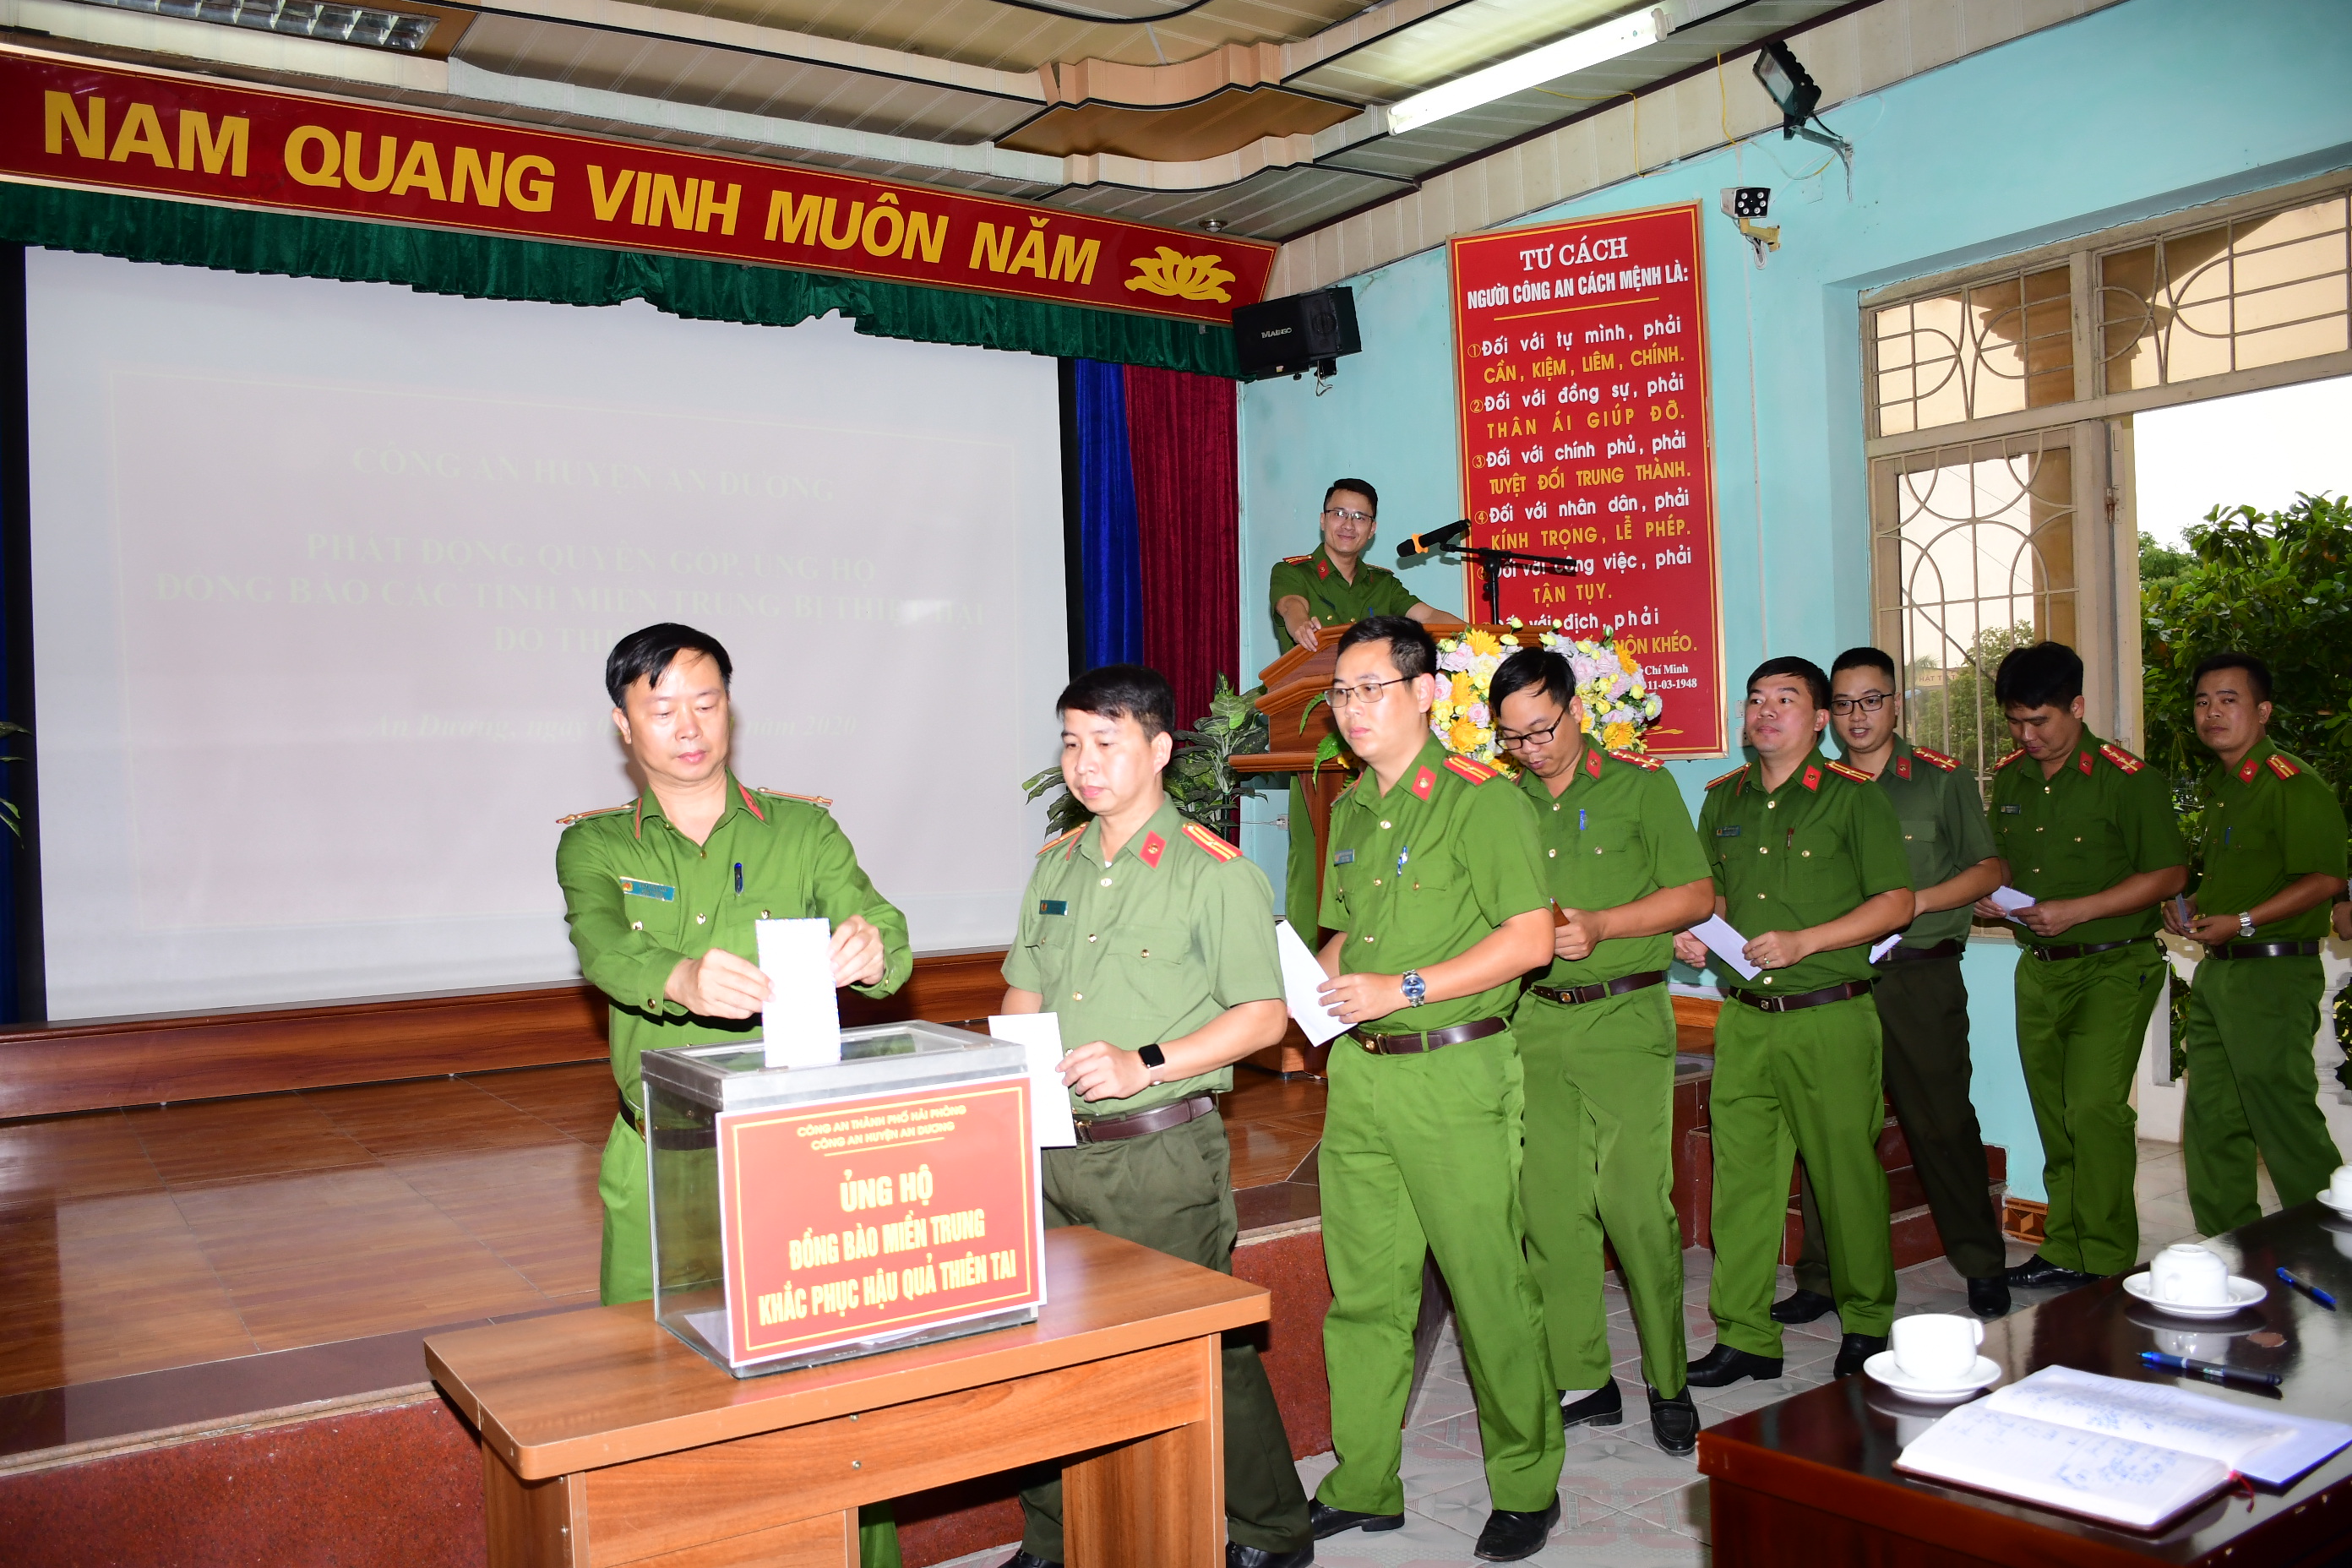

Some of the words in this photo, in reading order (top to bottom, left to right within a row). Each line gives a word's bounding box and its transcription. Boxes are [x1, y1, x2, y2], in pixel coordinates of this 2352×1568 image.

[44, 90, 250, 178] NAM
[284, 124, 556, 213] QUANG
[591, 165, 742, 237] VINH
[765, 192, 951, 264] MUÔN
[969, 216, 1102, 286] NĂM
[1520, 244, 1554, 271] TƯ
[1559, 235, 1629, 266] CÁCH
[1467, 282, 1509, 309] NGƯỜI
[1512, 280, 1550, 304] CÔNG
[1554, 280, 1574, 298] AN
[1578, 271, 1615, 296] CÁCH
[1620, 264, 1661, 292] MỆNH
[1665, 259, 1689, 282] LÀ:
[1482, 335, 1508, 357] Đối
[1520, 331, 1544, 351] với
[1556, 331, 1572, 351] tự
[1643, 314, 1681, 340] phải
[1631, 342, 1685, 368] CHÍNH.
[1484, 391, 1510, 412] Đối
[1522, 389, 1546, 408] với
[1558, 383, 1599, 405] đồng
[1647, 372, 1684, 398] phải
[1487, 416, 1537, 439] THÂN
[1552, 410, 1571, 433] ÁI
[1587, 404, 1635, 428] GIÚP
[1650, 400, 1685, 422] ĐỠ.
[1486, 447, 1511, 468] Đối
[1522, 444, 1544, 464] với
[1554, 440, 1595, 461] chính
[1652, 429, 1686, 455] phải
[352, 440, 461, 479] CÔNG
[472, 455, 520, 482] AN
[533, 457, 653, 495] HUYỆN
[662, 467, 708, 494] AN
[718, 468, 835, 504] DƯƠNG
[1489, 473, 1527, 497] TUYỆT
[1538, 466, 1565, 491] ĐỐI
[1576, 467, 1625, 487] TRUNG
[1636, 457, 1691, 482] THÀNH.
[1489, 503, 1513, 524] Đối
[1525, 501, 1547, 520] với
[1559, 498, 1596, 517] nhân
[1654, 487, 1690, 512] phải
[1491, 527, 1529, 551] KÍNH
[1615, 514, 1632, 541] LỄ
[1645, 514, 1691, 538] PHÉP.
[307, 529, 409, 565] PHÁT
[537, 538, 659, 575] QUYÊN
[1655, 545, 1692, 569] phải
[381, 575, 458, 608] CÁC
[670, 588, 781, 619] TRUNG
[1533, 582, 1566, 608] TẬN
[1576, 583, 1613, 606] TỤY.
[1614, 606, 1659, 630] phải
[494, 625, 545, 653] DO
[1652, 629, 1697, 654] KHÉO.
[1644, 664, 1661, 676] Chí
[1663, 664, 1689, 675] Minh
[1647, 678, 1697, 690] 11-03-1948
[797, 1124, 832, 1138] CÔNG
[833, 1121, 850, 1133] AN
[851, 1115, 885, 1130] THÀNH
[887, 1110, 909, 1124] PHỐ
[911, 1108, 928, 1121] HẢI
[929, 1104, 967, 1119] PHÒNG
[810, 1136, 846, 1151] CÔNG
[847, 1135, 863, 1146] AN
[864, 1129, 899, 1142] HUYỆN
[900, 1126, 916, 1139] AN
[840, 1168, 893, 1212] ỦNG
[899, 1163, 934, 1206] HỘ
[788, 1227, 840, 1271] ĐỒNG
[843, 1222, 879, 1261] BÀO
[882, 1210, 928, 1254] MIỀN
[930, 1208, 985, 1246] TRUNG
[758, 1280, 807, 1326] KHẮC
[812, 1278, 859, 1317] PHỤC
[863, 1267, 898, 1309] HẬU
[902, 1252, 937, 1300] QUẢ
[939, 1251, 988, 1291] THIÊN
[990, 1250, 1016, 1281] TAI
